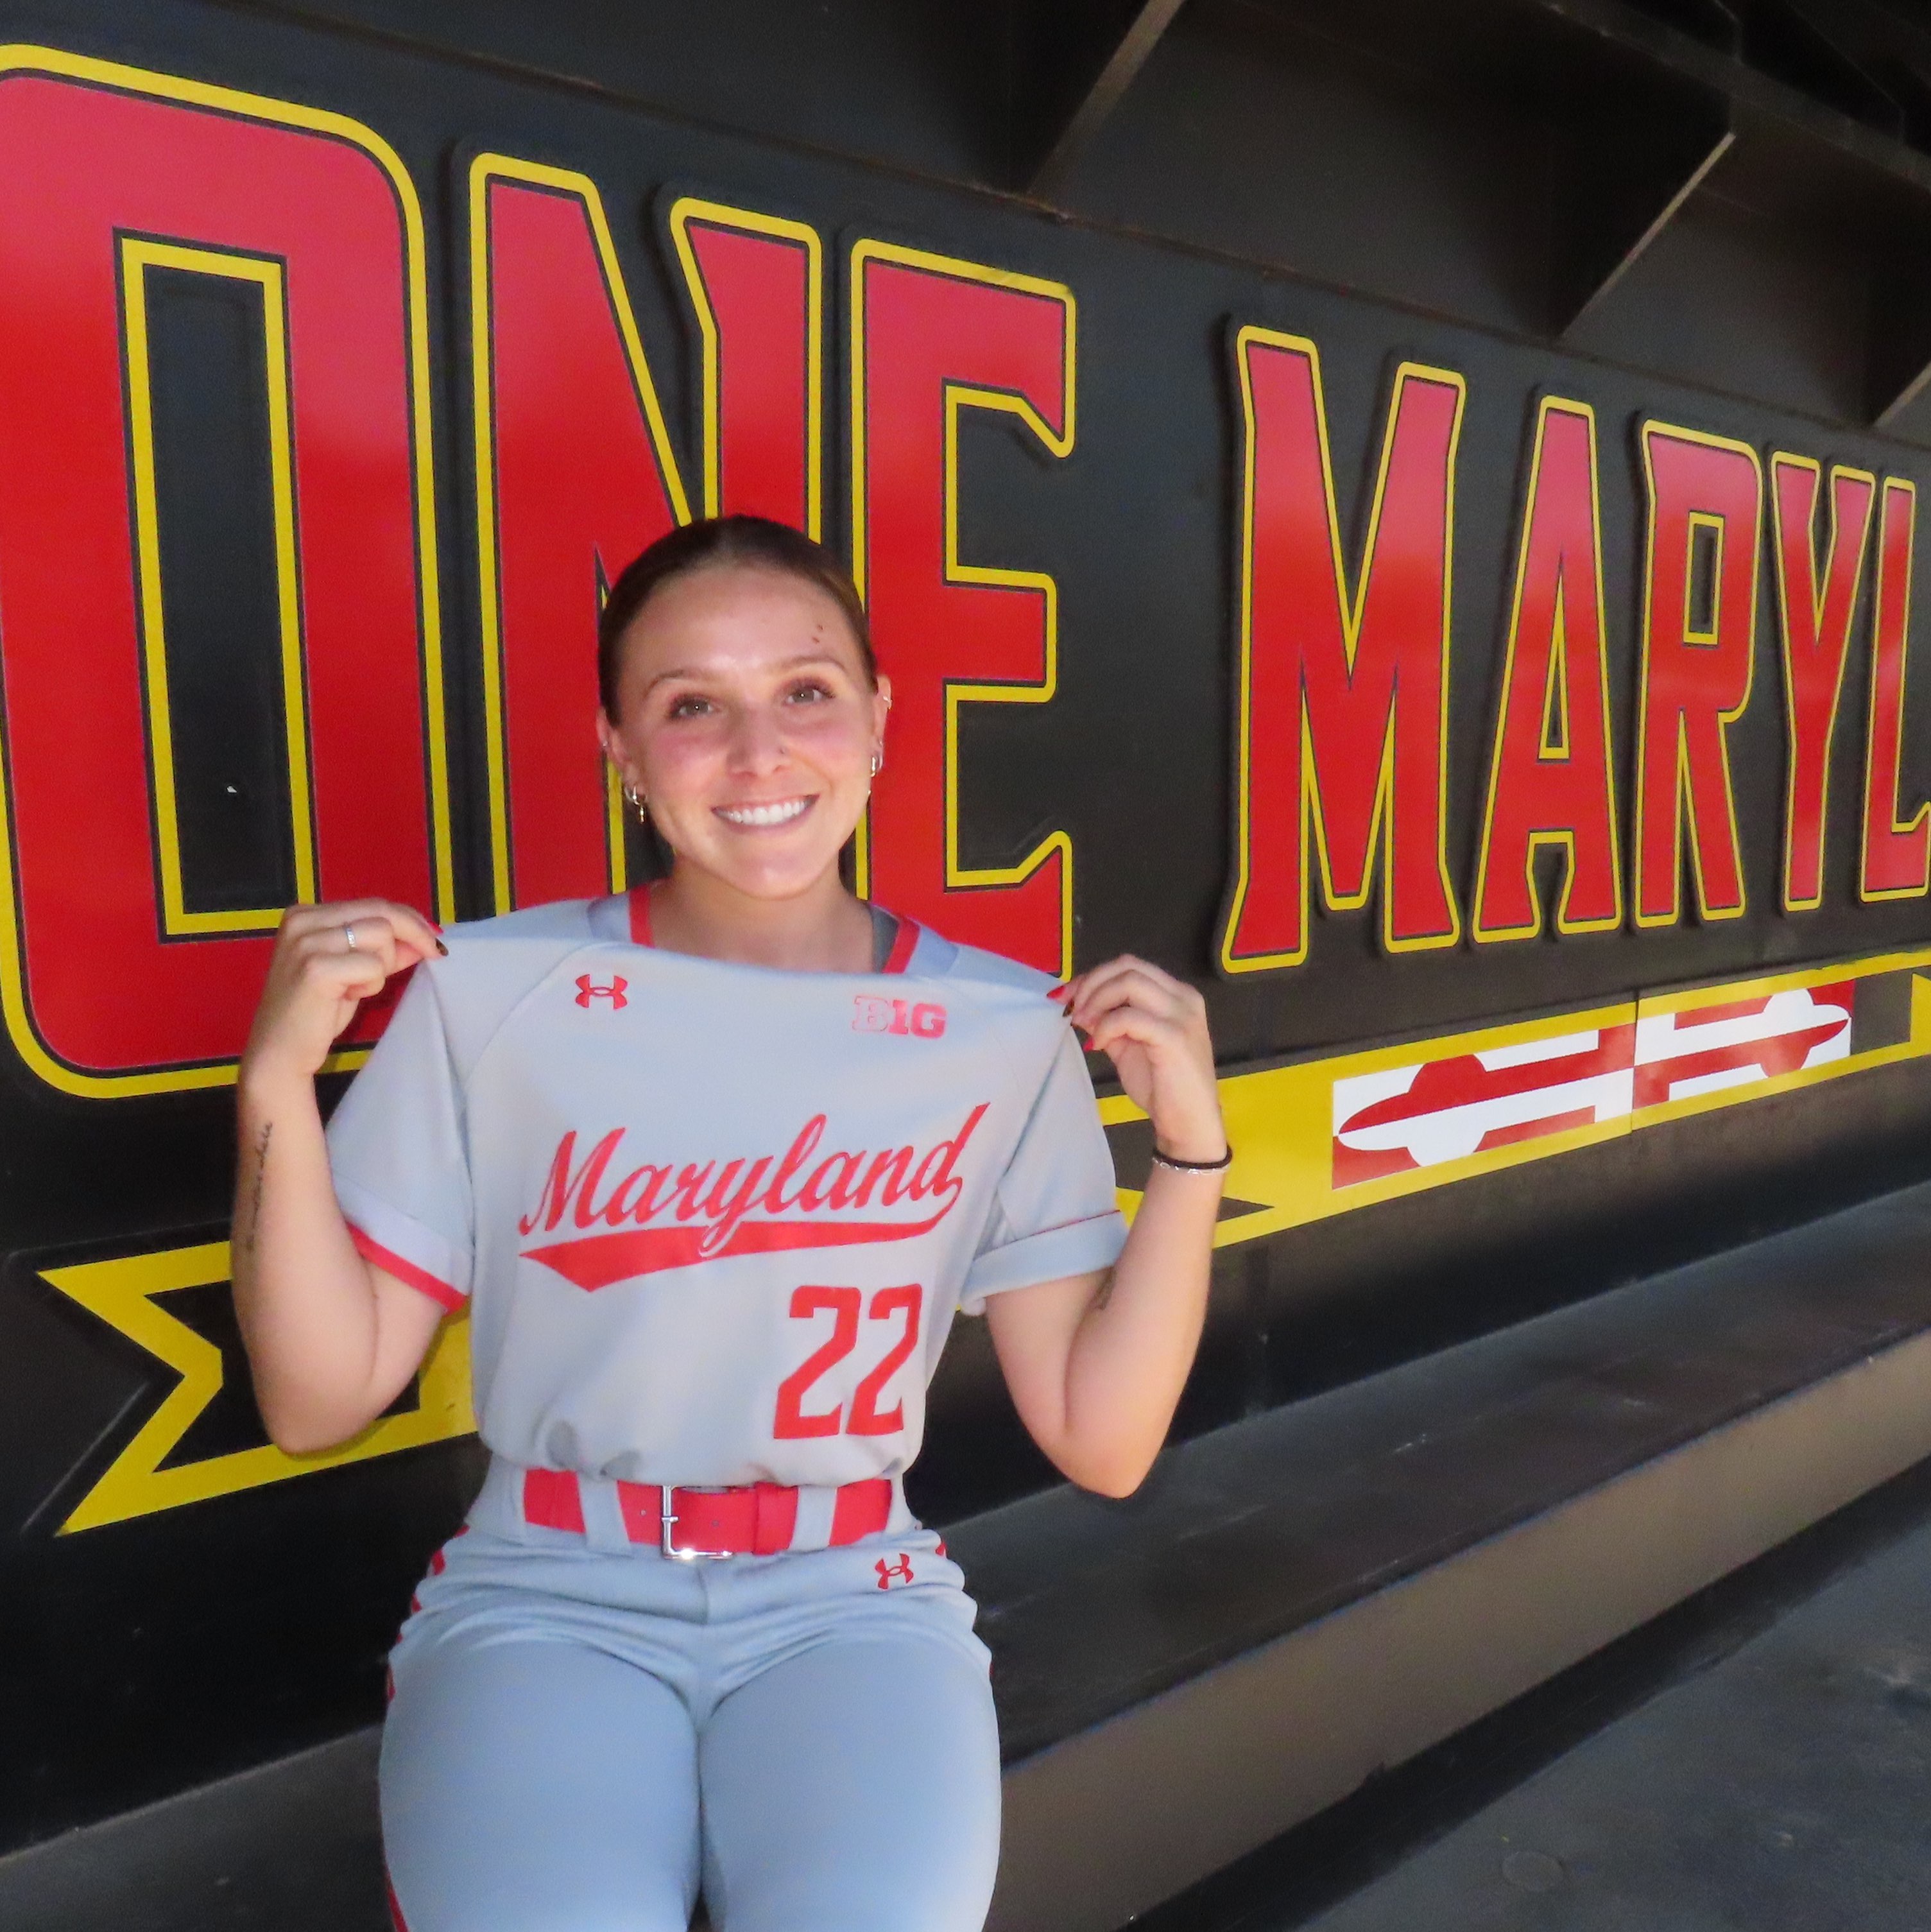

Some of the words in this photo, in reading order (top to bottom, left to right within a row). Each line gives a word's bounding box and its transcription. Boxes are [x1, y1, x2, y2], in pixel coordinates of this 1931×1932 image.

[0, 44, 1076, 1098] ONE
[1221, 325, 1931, 974] MARYL
[519, 1101, 991, 1255] Maryland
[773, 1283, 922, 1439] 22
